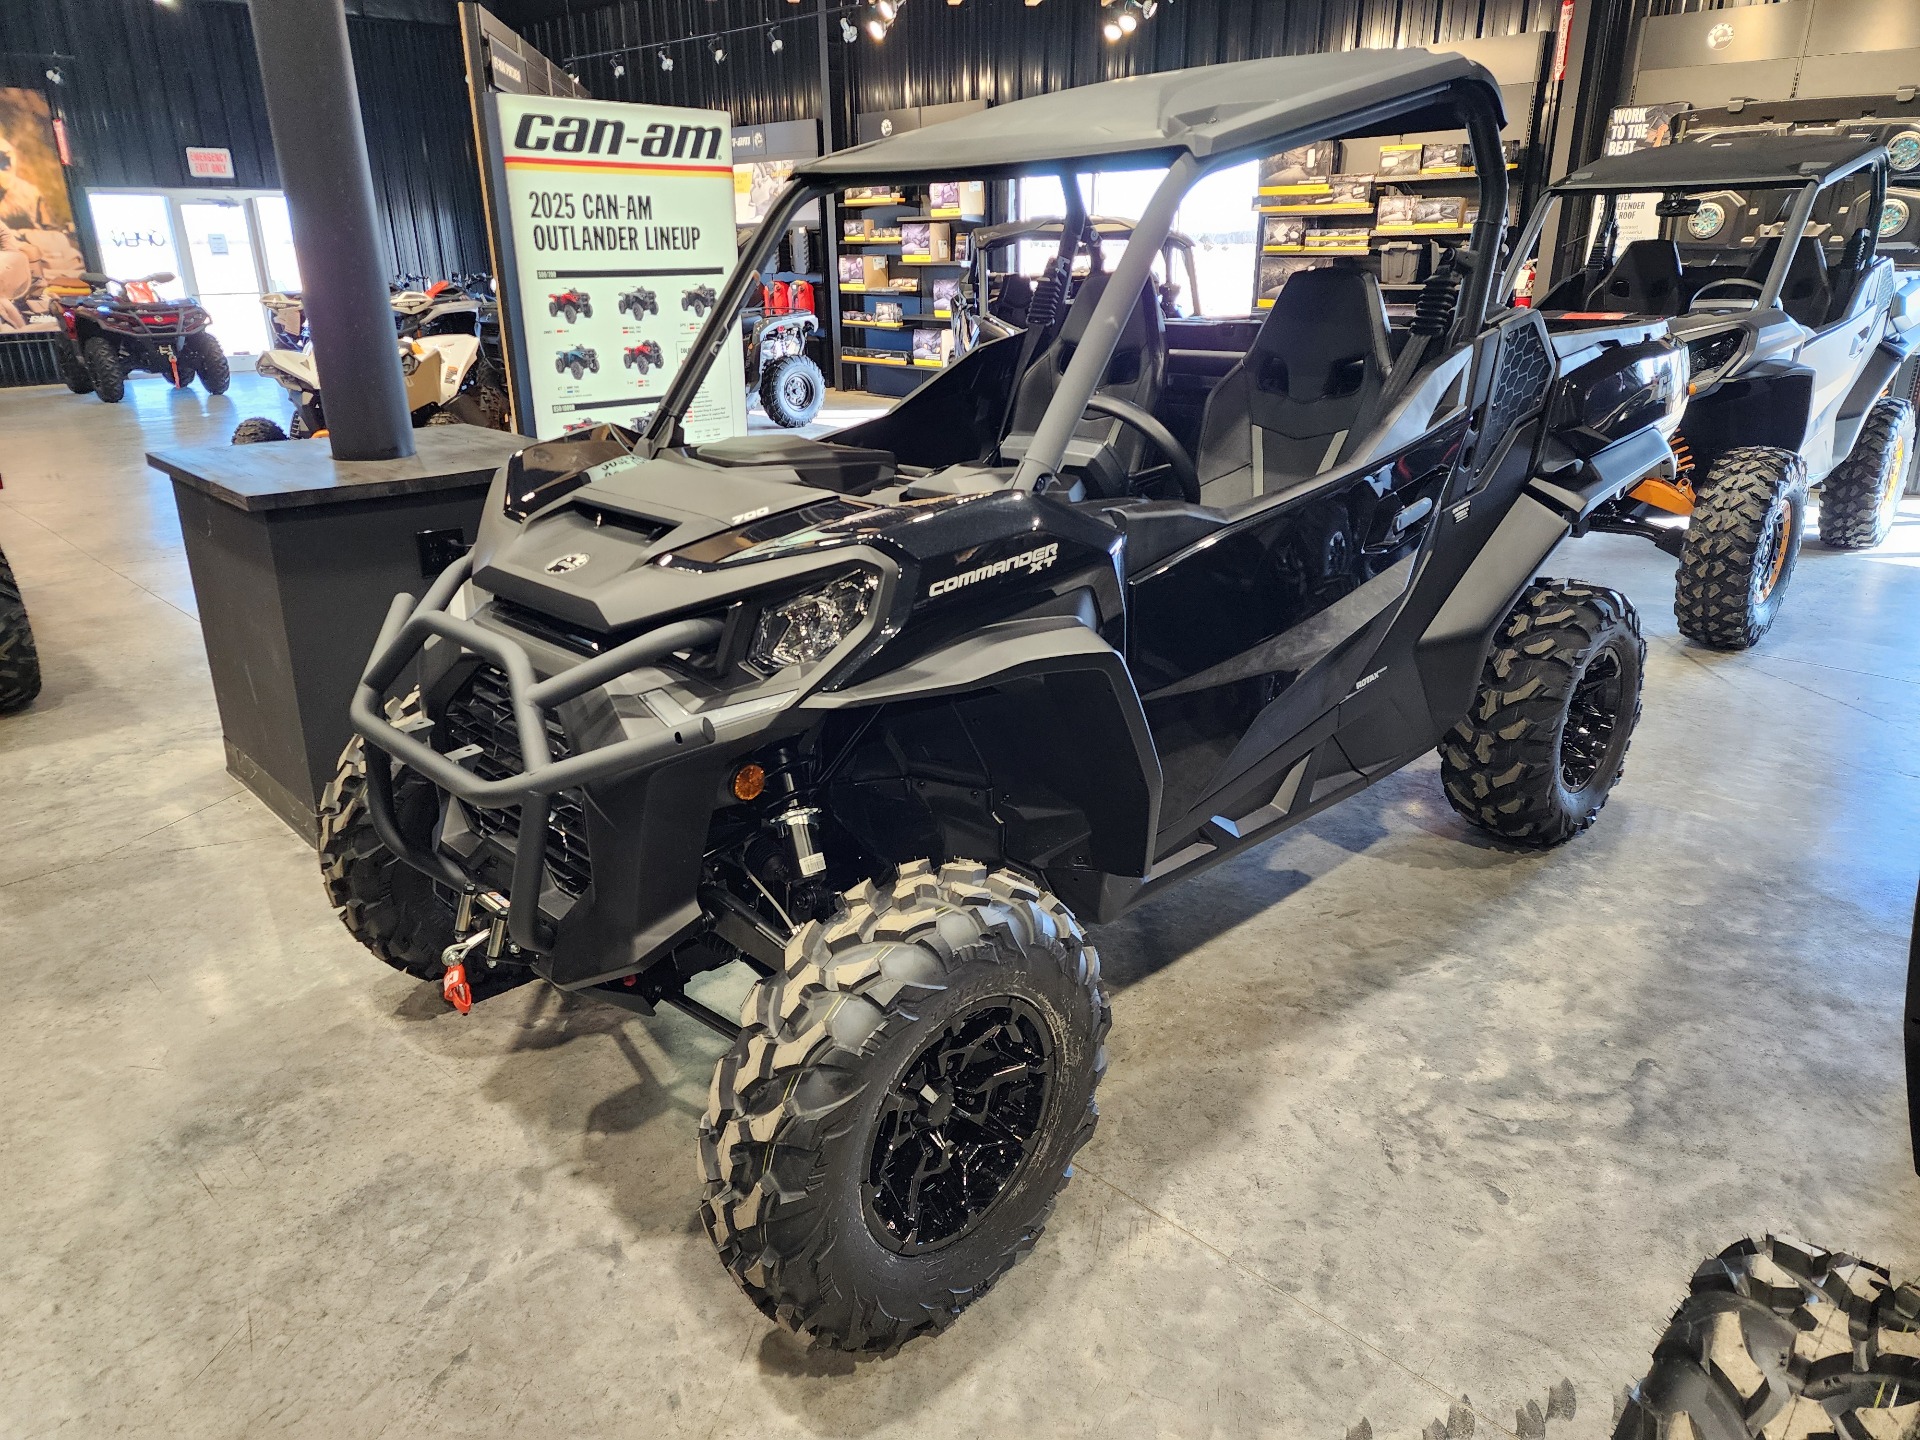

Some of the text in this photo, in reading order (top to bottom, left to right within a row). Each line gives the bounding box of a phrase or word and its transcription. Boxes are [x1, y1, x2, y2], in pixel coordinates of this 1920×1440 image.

[1613, 107, 1648, 124] WORK
[514, 112, 723, 160] can-am
[1611, 123, 1649, 140] TO THE
[1607, 140, 1637, 156] BEAT
[190, 152, 227, 162] EMERGENCY
[195, 162, 226, 173] EXIT ONLY
[529, 191, 653, 220] 2025 CAN-AM
[1617, 202, 1646, 210] EFENDER
[1618, 210, 1636, 219] ROOF
[533, 225, 701, 251] OUTLANDER LINEUP
[731, 506, 769, 525] 700
[928, 542, 1059, 598] COMMANDER
[1028, 555, 1058, 575] XT
[1355, 672, 1380, 690] ROTAX
